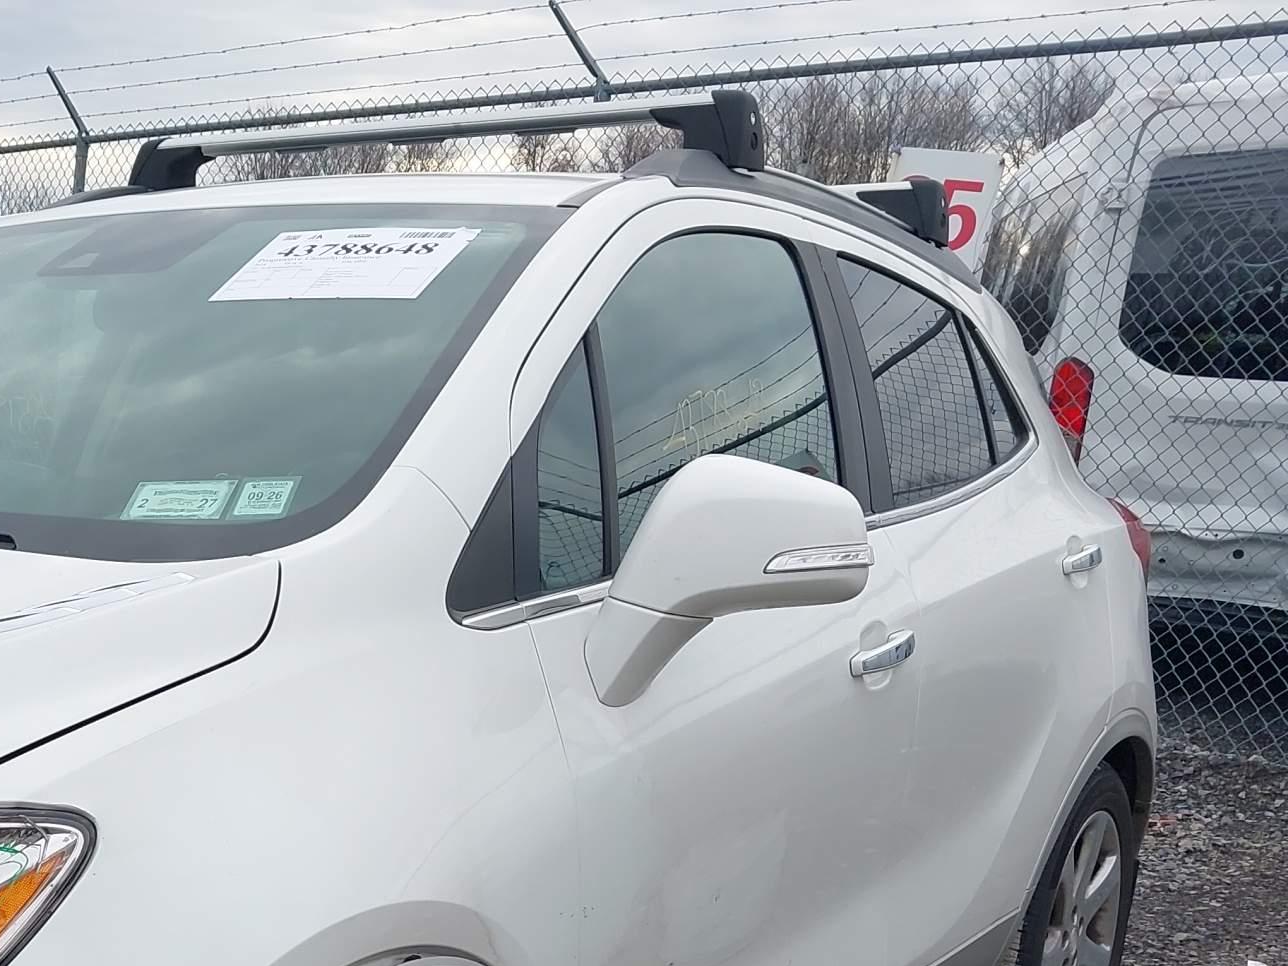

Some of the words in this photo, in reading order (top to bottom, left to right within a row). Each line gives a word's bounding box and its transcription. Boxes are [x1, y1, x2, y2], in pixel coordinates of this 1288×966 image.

[277, 241, 440, 258] 43788648
[1168, 415, 1273, 429] TRANSIT
[248, 491, 264, 501] 09
[267, 490, 283, 500] 26
[137, 498, 149, 509] 2
[197, 498, 218, 509] 27
